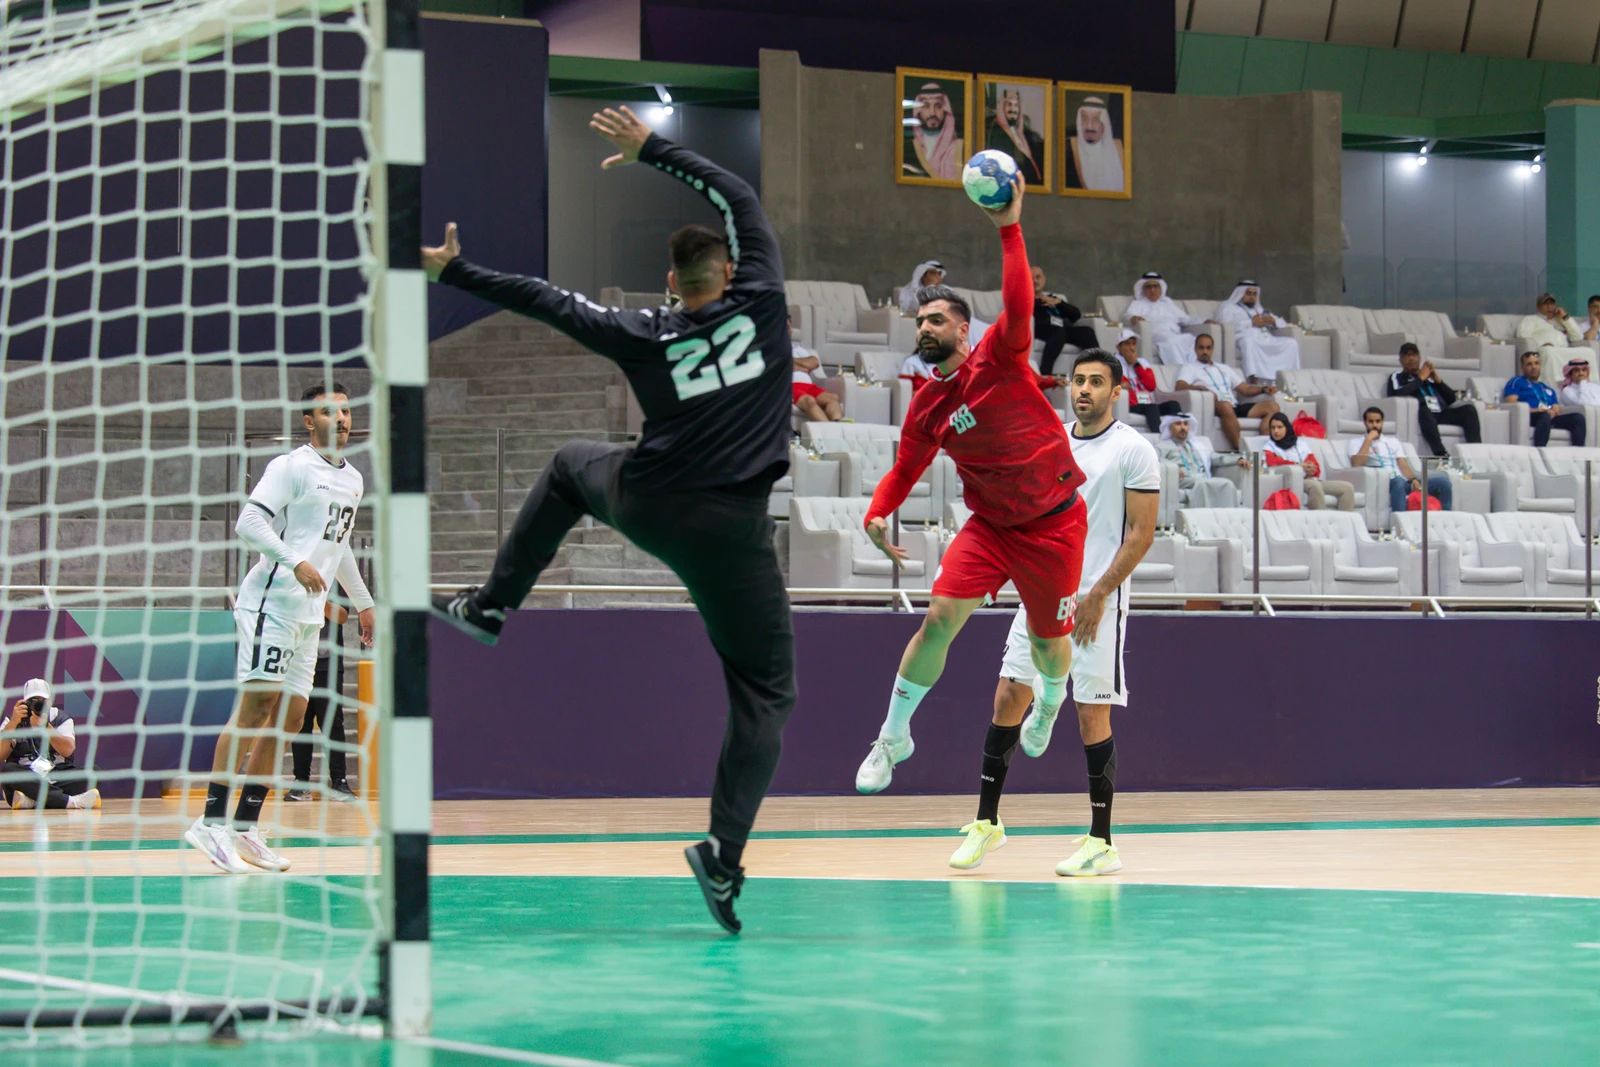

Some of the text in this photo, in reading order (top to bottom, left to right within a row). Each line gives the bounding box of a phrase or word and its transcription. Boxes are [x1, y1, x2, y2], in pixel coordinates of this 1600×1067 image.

[665, 314, 766, 401] 22
[949, 403, 977, 435] 88
[322, 501, 354, 543] 23
[263, 646, 294, 674] 23
[980, 773, 995, 782] AKO
